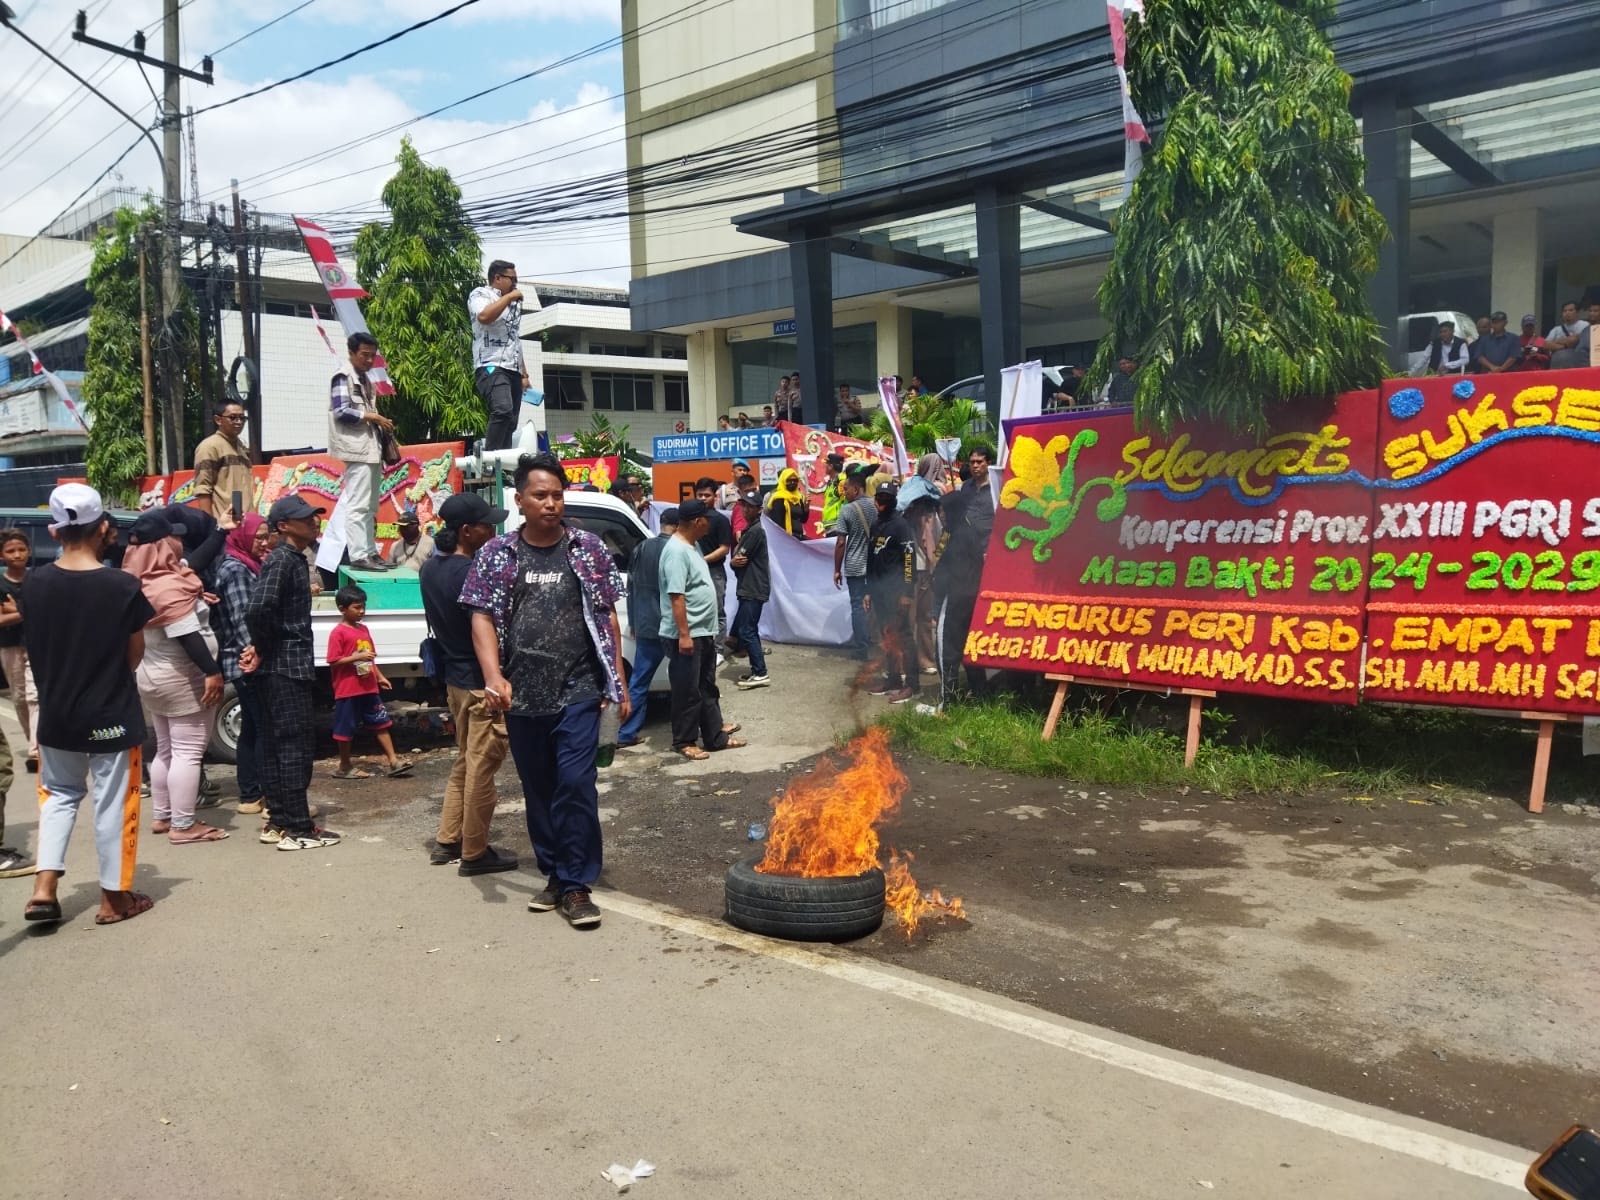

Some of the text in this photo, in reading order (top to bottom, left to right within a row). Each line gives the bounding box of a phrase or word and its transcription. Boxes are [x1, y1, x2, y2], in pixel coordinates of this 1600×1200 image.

[776, 324, 789, 333] ATM
[657, 433, 785, 453] SUDIRMAN OFFICE TO
[657, 448, 699, 457] CITY CENTRE
[1114, 385, 1600, 497] Selamat SUKSE
[1119, 509, 1288, 552] Konferensi
[1290, 510, 1370, 545] Prov.
[1373, 500, 1467, 539] XXIII
[1473, 499, 1572, 546] PGRI
[1079, 555, 1177, 588] Masa
[1185, 555, 1295, 598] Bakti
[985, 600, 1156, 636] PENGURUS
[1162, 609, 1256, 650] PGRI
[1391, 616, 1573, 655] EMPAT
